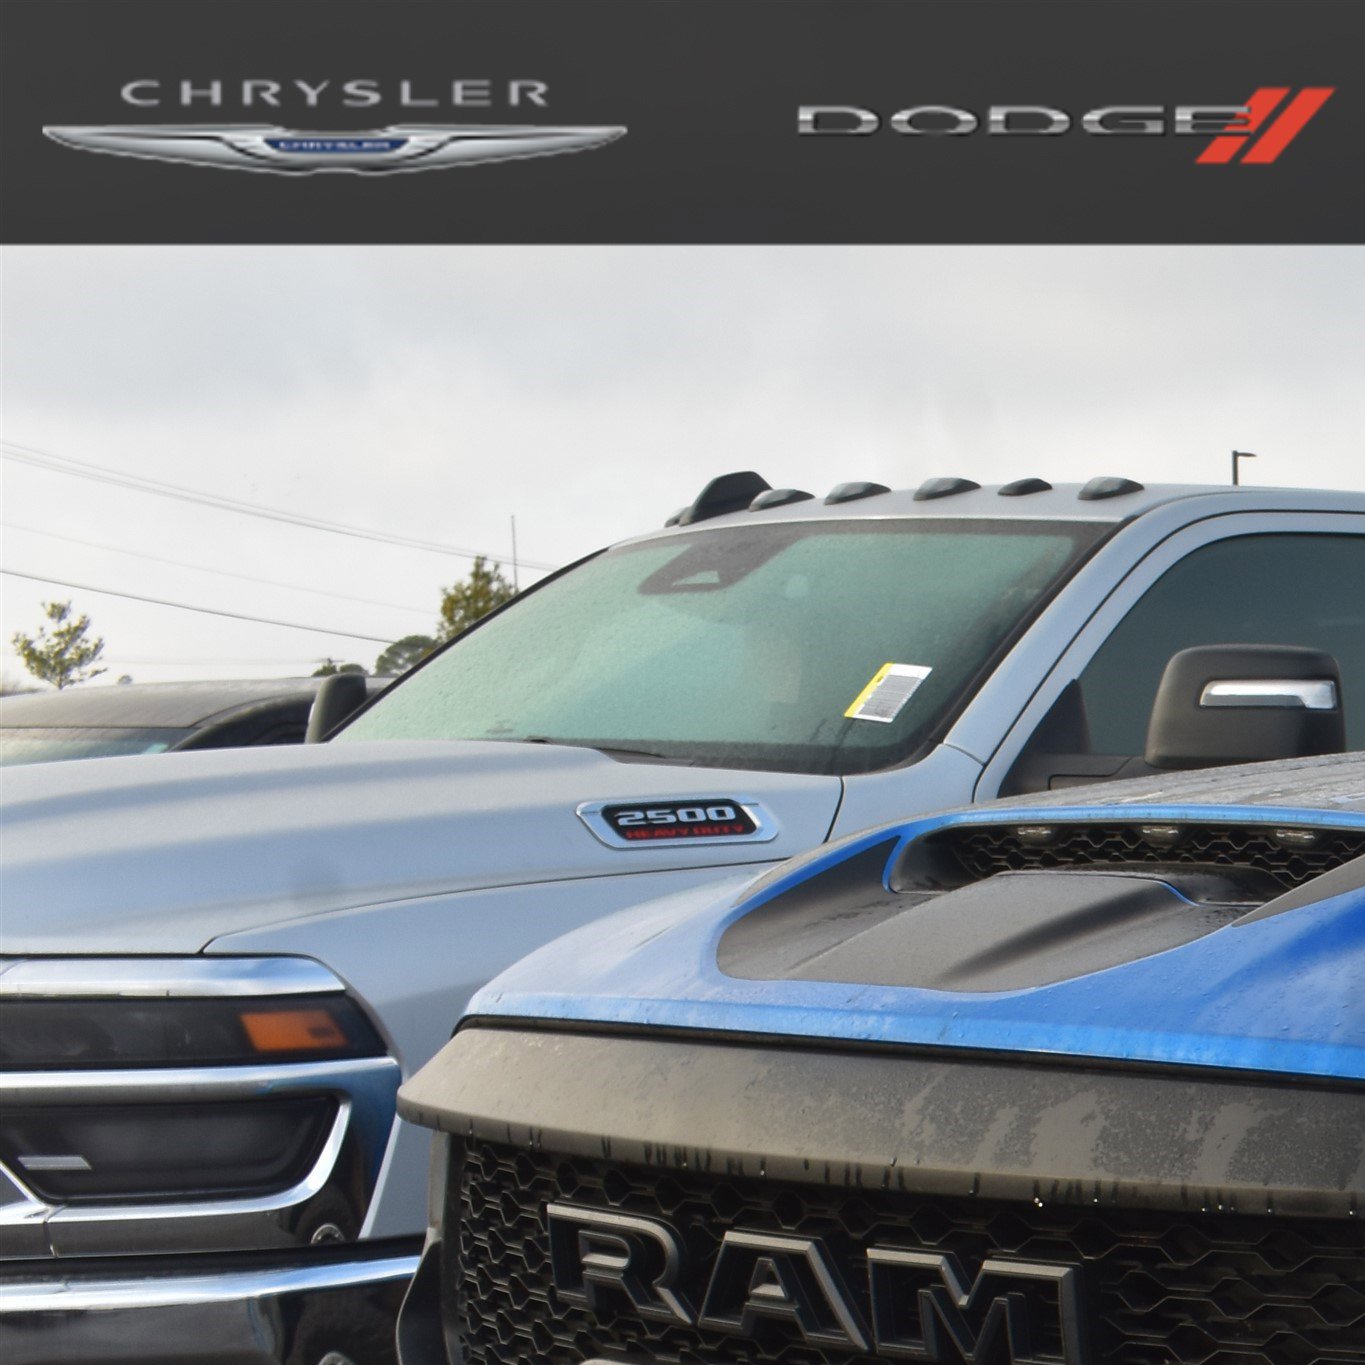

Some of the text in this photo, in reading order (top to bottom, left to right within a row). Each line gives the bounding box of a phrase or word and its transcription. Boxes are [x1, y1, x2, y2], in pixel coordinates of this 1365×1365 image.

[615, 806, 736, 826] 2500
[625, 825, 746, 840] HEAVY DUTY
